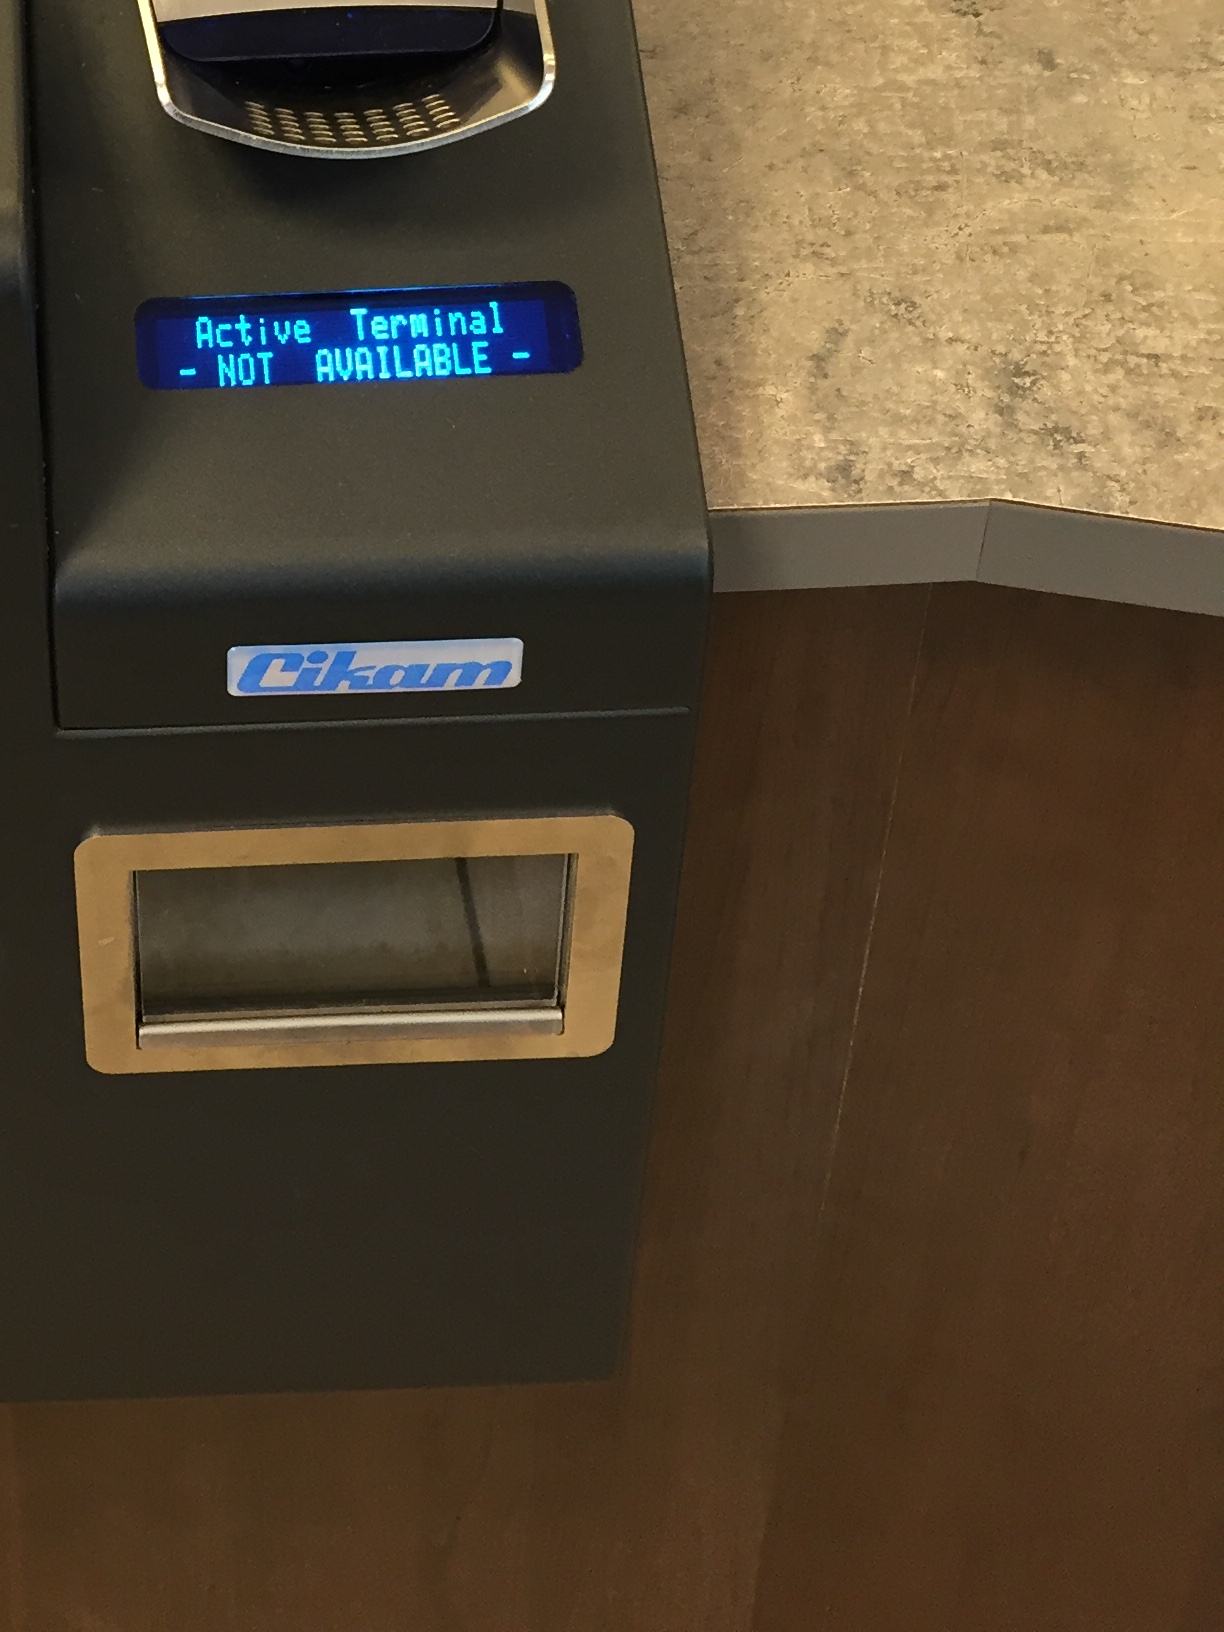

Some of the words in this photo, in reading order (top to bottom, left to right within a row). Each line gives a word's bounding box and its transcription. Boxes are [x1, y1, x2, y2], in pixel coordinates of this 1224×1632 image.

[194, 314, 312, 348] Active
[349, 301, 504, 341] Terminal
[218, 351, 274, 387] NOT
[315, 341, 493, 383] AVAILABLE
[236, 649, 514, 695] Cikam
